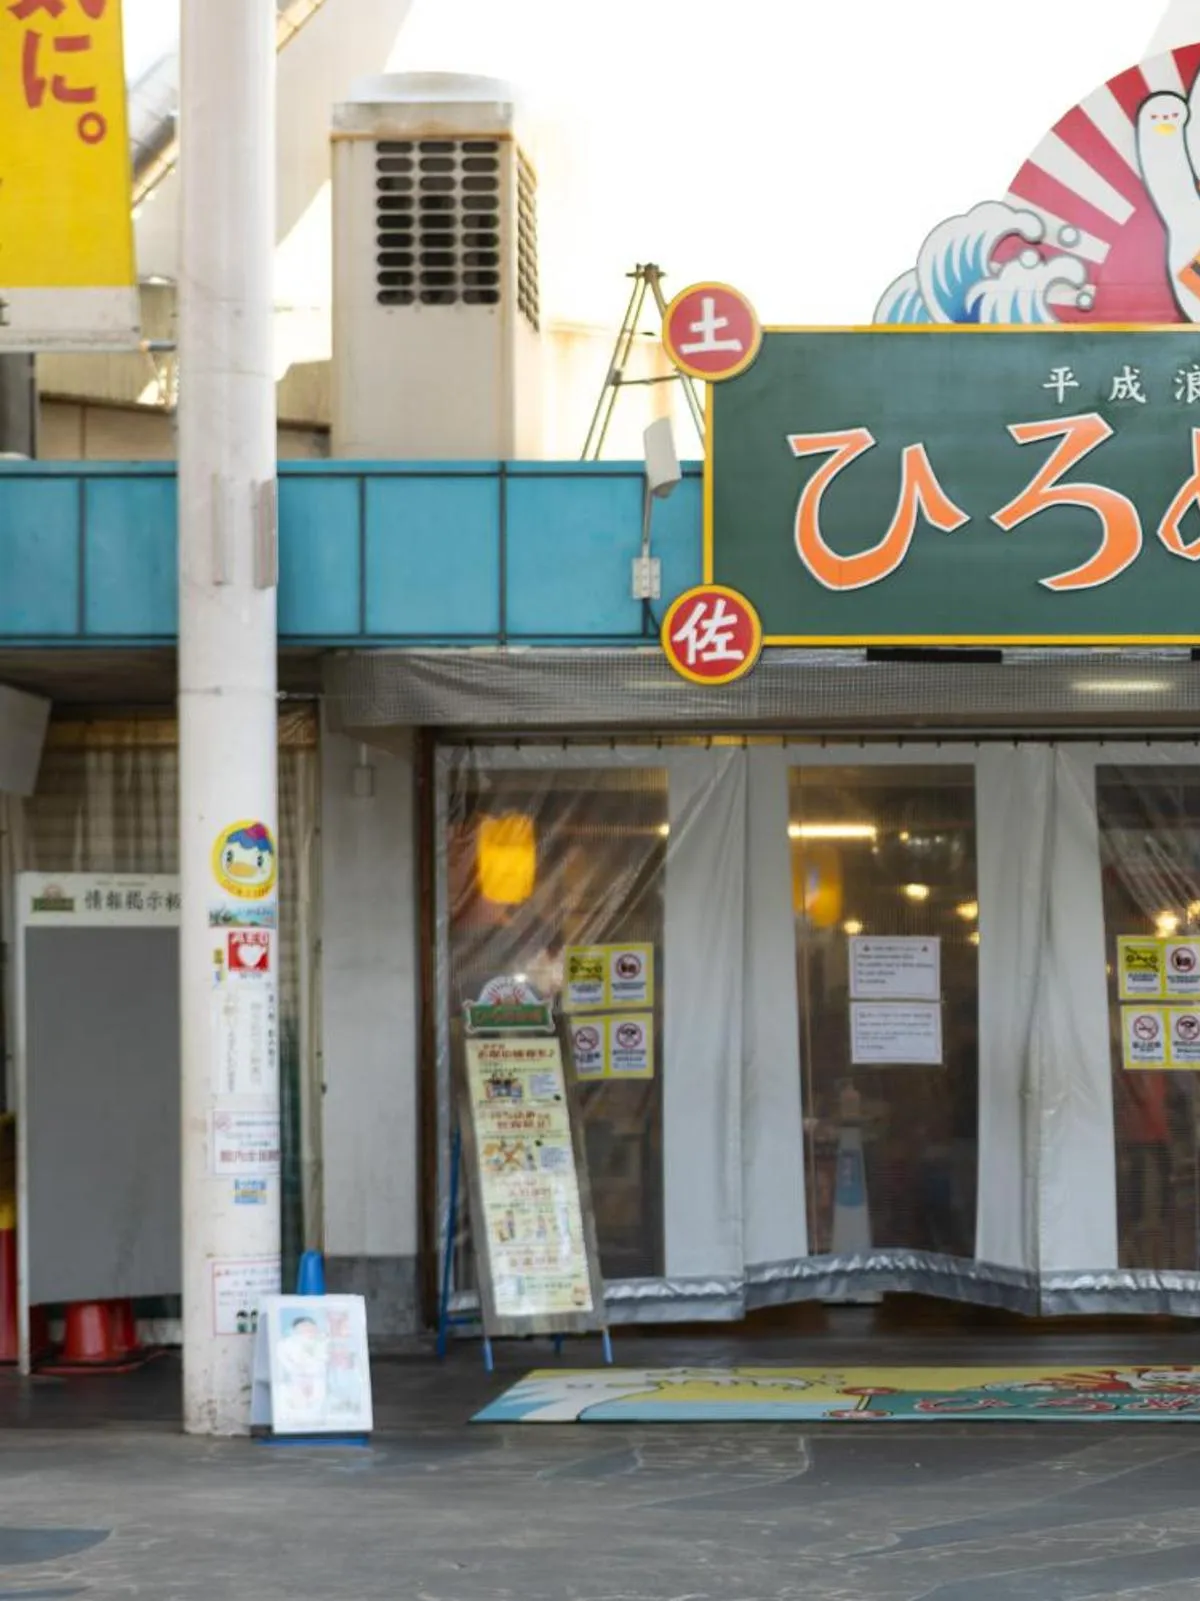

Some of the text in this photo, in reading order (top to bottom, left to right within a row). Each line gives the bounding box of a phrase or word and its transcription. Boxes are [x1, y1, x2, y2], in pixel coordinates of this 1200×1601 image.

[7, 0, 107, 144] に。
[680, 298, 743, 355] 土
[673, 599, 744, 666] 佐
